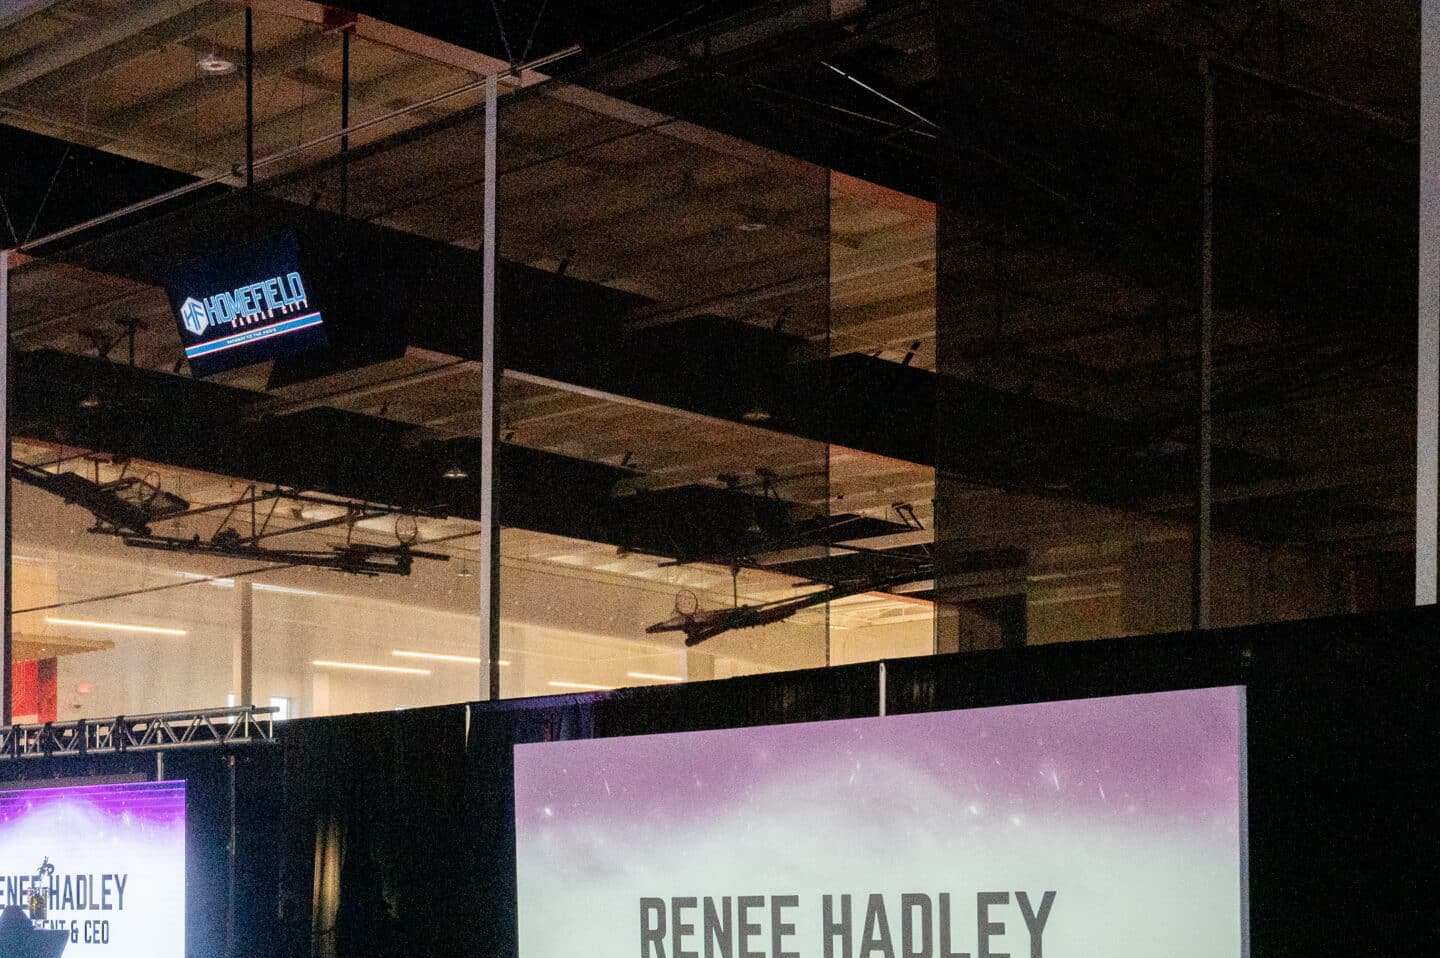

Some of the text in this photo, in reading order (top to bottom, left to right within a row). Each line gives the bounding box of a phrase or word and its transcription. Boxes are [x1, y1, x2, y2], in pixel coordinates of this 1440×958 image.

[203, 272, 307, 327] HOMEFIELD
[49, 874, 128, 911] HADLEY
[70, 919, 79, 944] &
[84, 919, 110, 944] CEO
